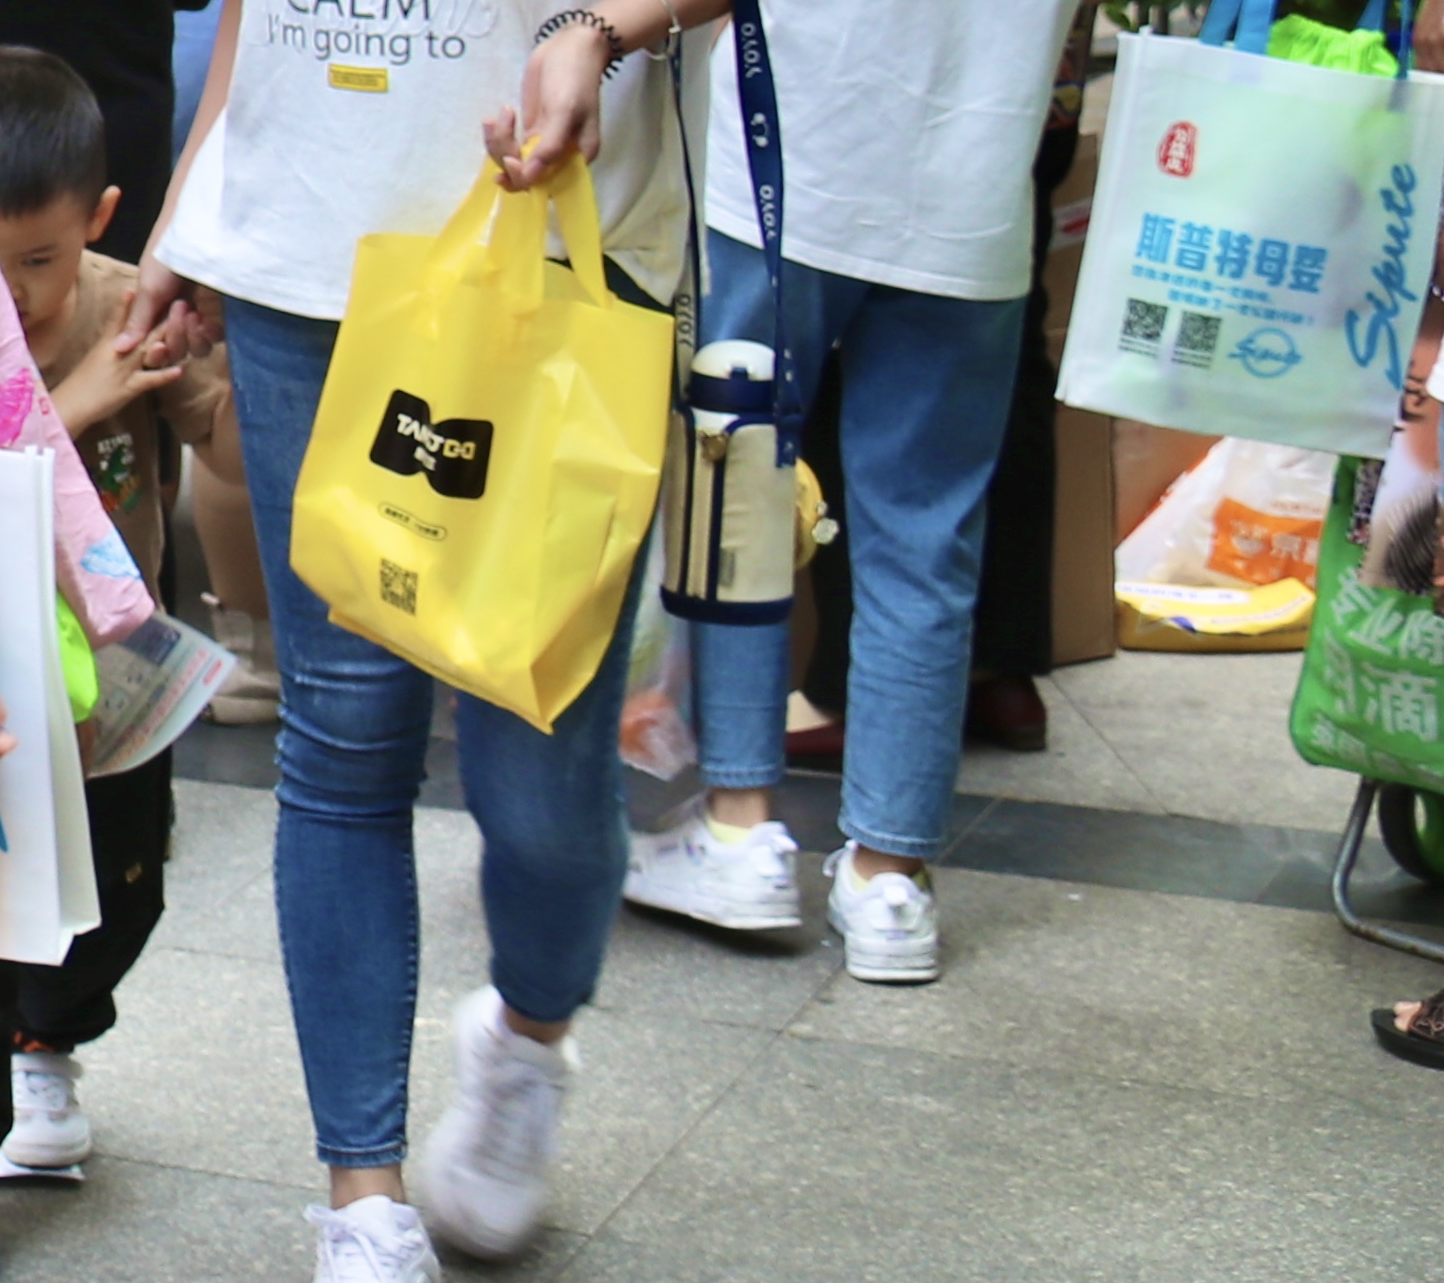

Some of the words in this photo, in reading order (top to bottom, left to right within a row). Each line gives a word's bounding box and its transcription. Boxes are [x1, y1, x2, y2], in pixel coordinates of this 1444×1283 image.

[268, 13, 306, 49] I'm
[313, 24, 411, 66] going
[425, 31, 466, 59] to
[1134, 212, 1328, 294] 斯普特母婴
